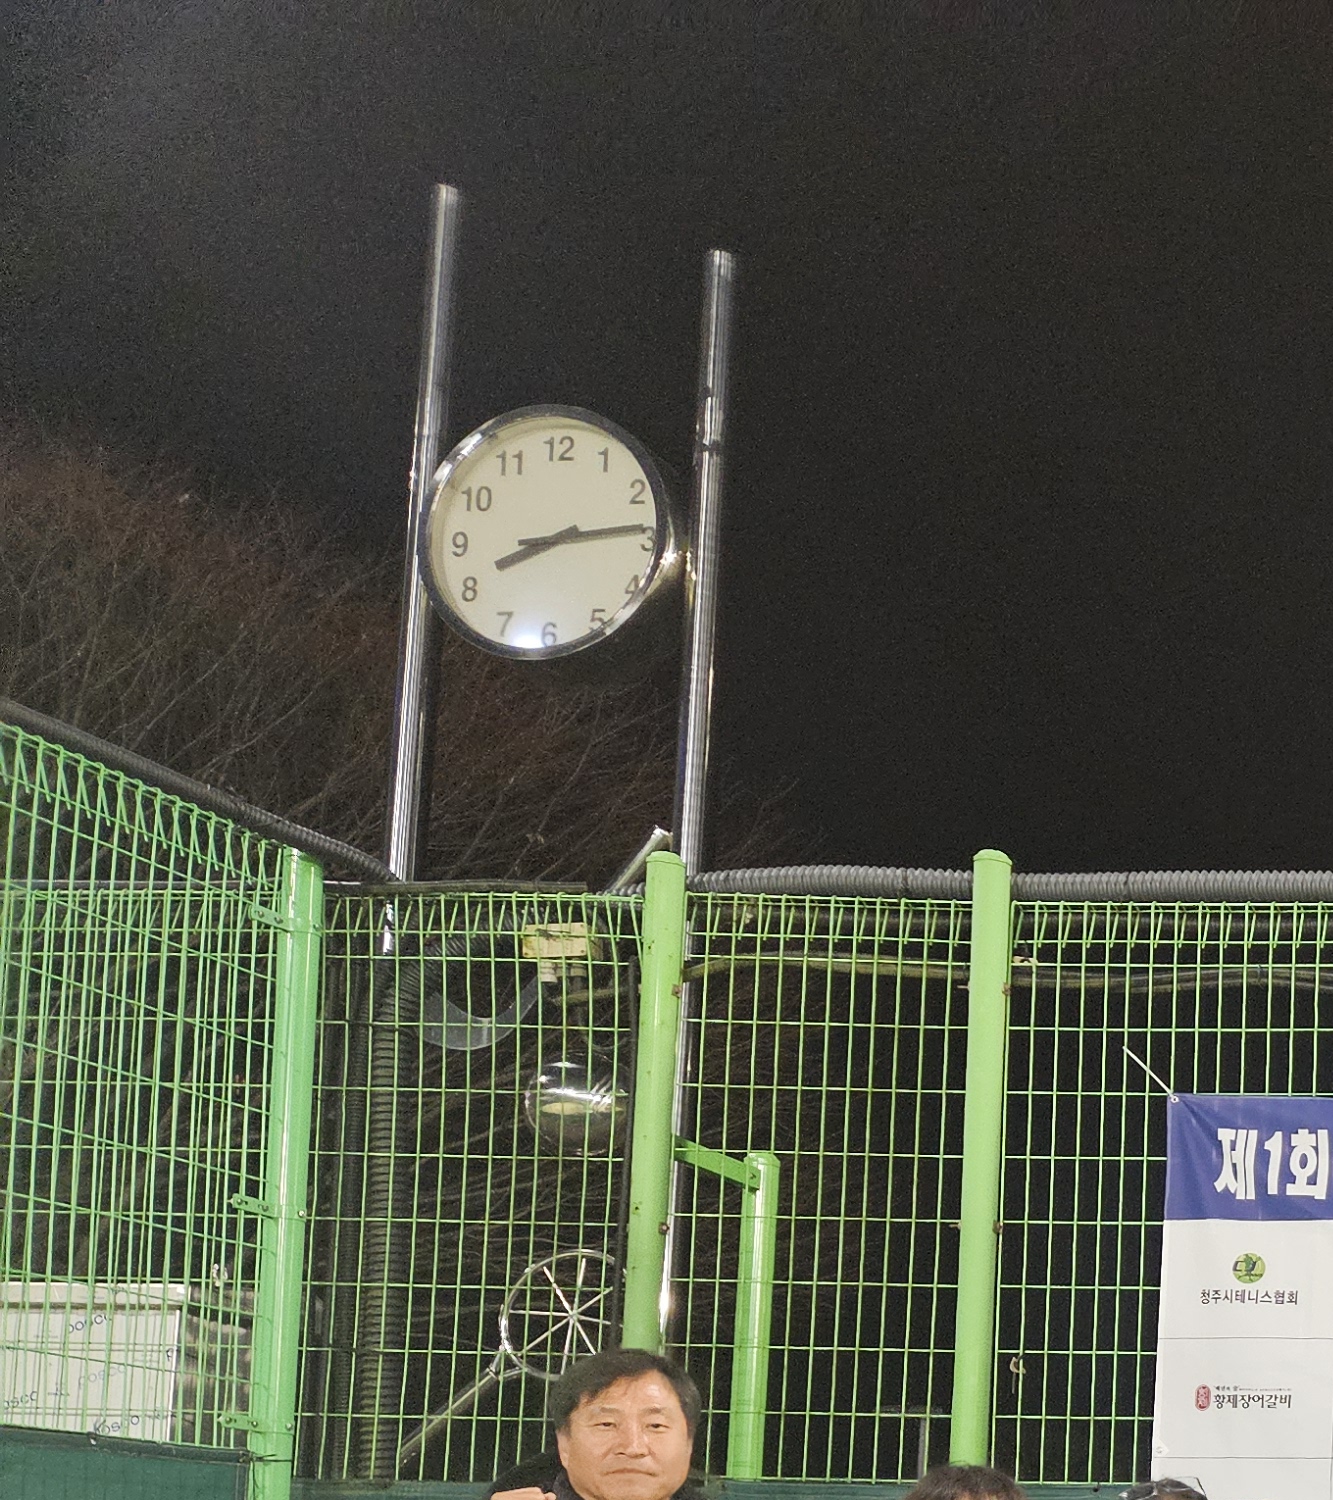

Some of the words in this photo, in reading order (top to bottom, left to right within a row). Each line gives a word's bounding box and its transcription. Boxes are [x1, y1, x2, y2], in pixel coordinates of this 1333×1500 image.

[544, 436, 575, 462] 12
[598, 447, 609, 473] 1
[496, 451, 523, 476] 11
[461, 486, 492, 511] 10
[629, 479, 646, 504] 2
[452, 532, 468, 557] 9
[640, 526, 656, 552] 3
[461, 577, 478, 602] 8
[497, 611, 514, 637] 7
[541, 622, 557, 647] 6
[589, 609, 607, 636] 5
[1214, 1128, 1328, 1201] 제1회
[1200, 1288, 1298, 1306] 청주시테니스협회
[1213, 1393, 1291, 1409] 황제장어갈비
